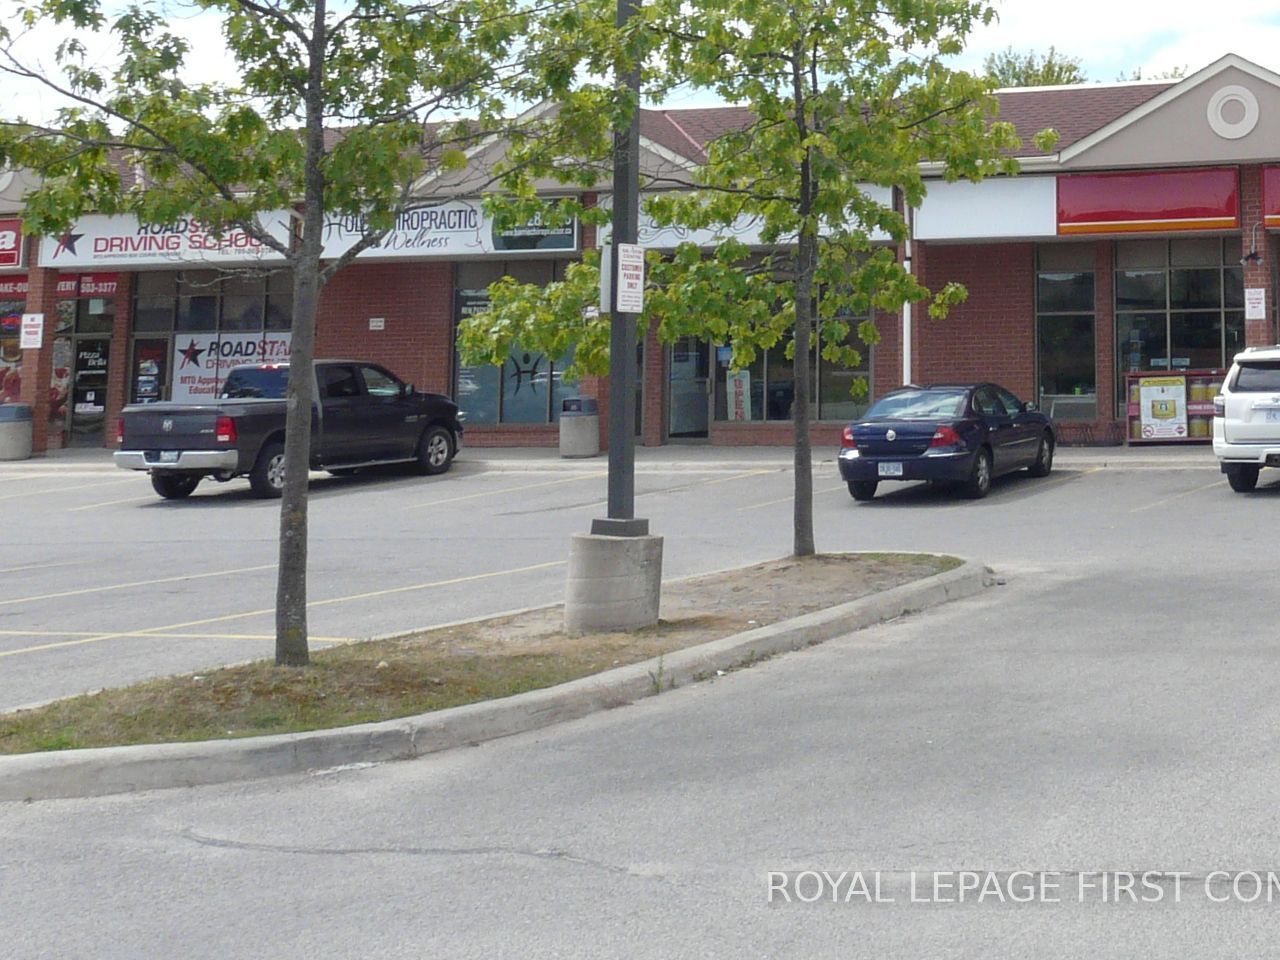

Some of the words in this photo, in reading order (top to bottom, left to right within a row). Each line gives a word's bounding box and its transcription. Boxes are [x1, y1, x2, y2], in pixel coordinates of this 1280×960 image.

[93, 235, 181, 253] DRIVING
[188, 233, 264, 250] SCHOO
[384, 227, 450, 250] Wellness
[207, 340, 292, 357] ROADSTA
